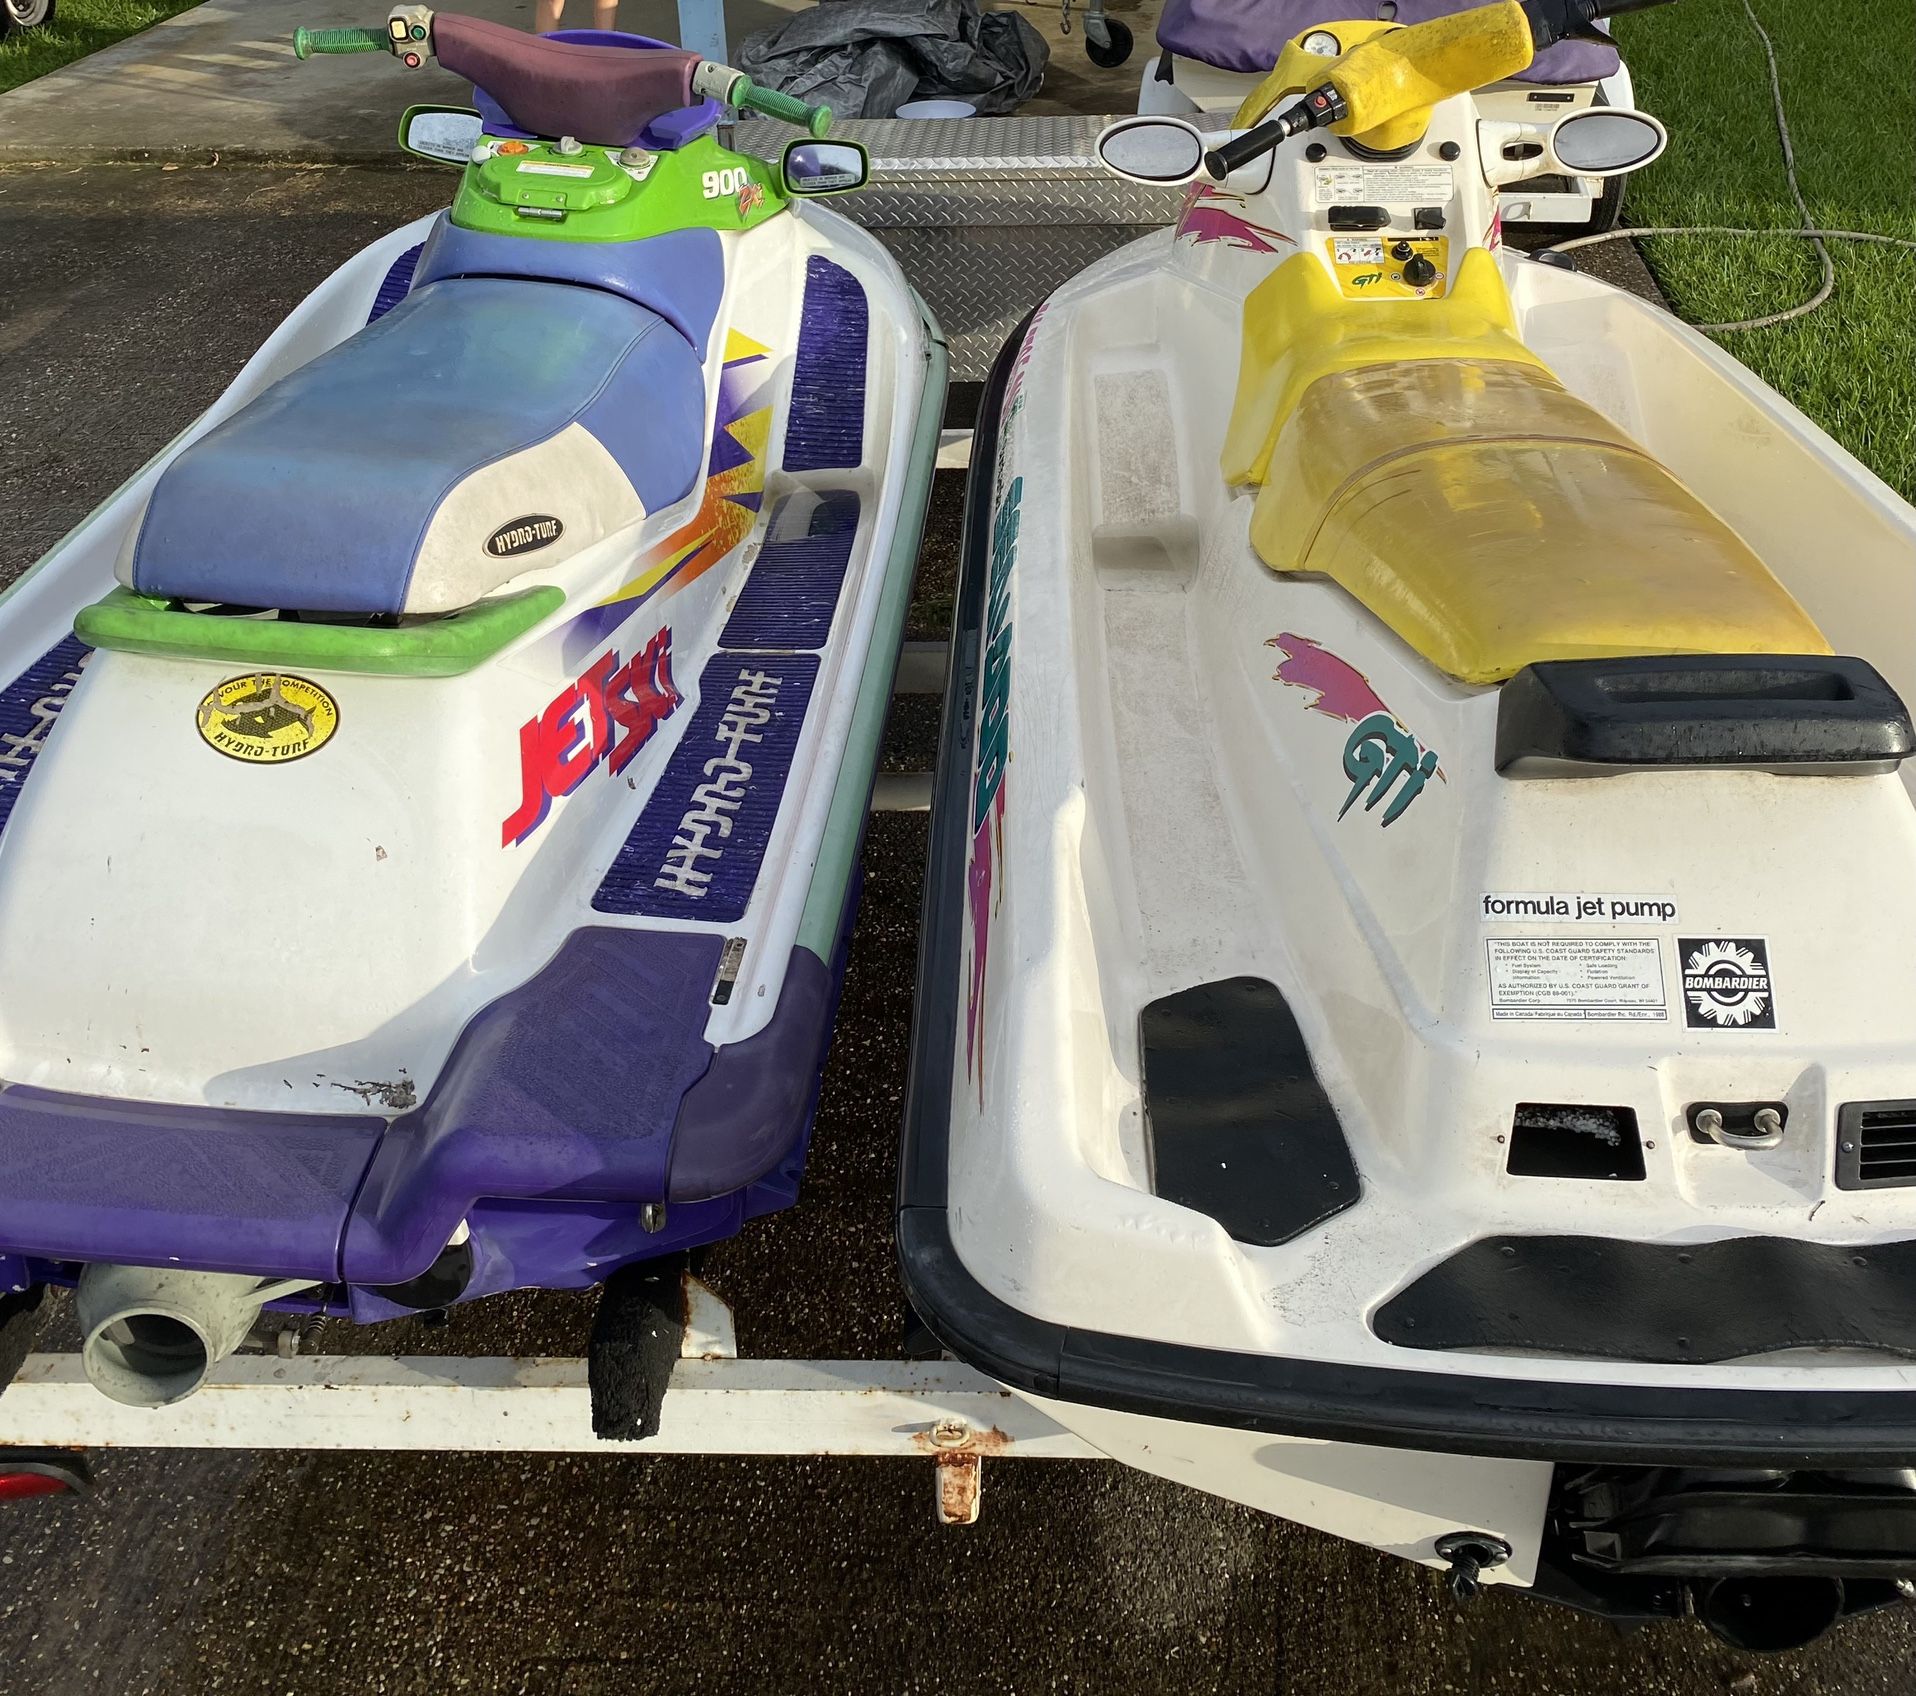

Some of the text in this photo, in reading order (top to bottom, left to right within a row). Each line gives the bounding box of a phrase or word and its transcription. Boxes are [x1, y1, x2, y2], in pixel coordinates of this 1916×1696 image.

[702, 166, 748, 199] 900
[495, 520, 557, 554] HYDRO-TURF
[281, 679, 333, 716] OMPETITION
[213, 731, 310, 758] HYDRO-TURF
[500, 623, 686, 850] JET SKI
[653, 667, 785, 898] HYDRO-TURF
[1483, 895, 1677, 921] formula jet pump
[1685, 976, 1768, 989] BOMBARDIER
